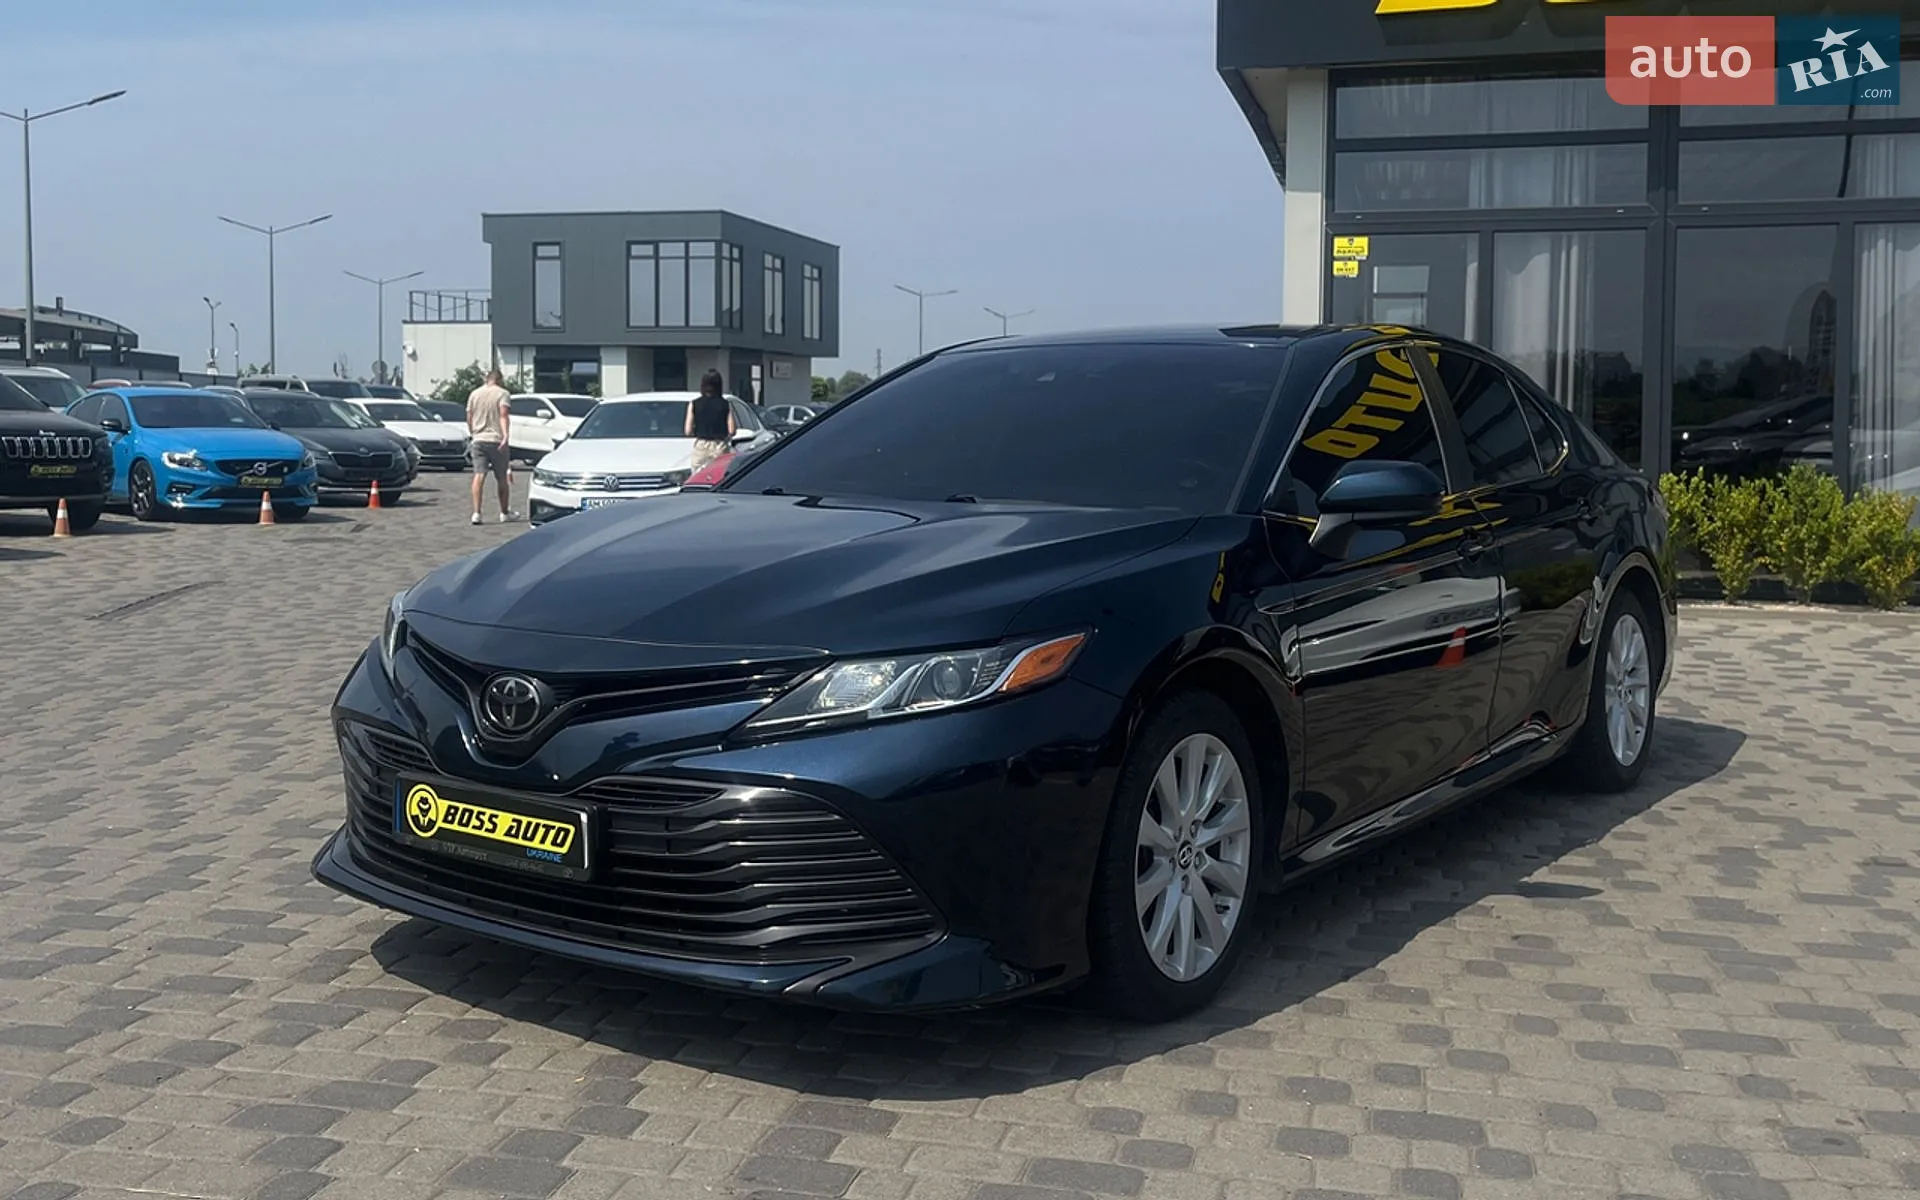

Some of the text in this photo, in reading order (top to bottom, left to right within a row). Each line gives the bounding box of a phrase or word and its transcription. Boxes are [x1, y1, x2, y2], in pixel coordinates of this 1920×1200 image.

[441, 804, 571, 848] BOSS AUTO
[526, 848, 563, 863] UKRAINE
